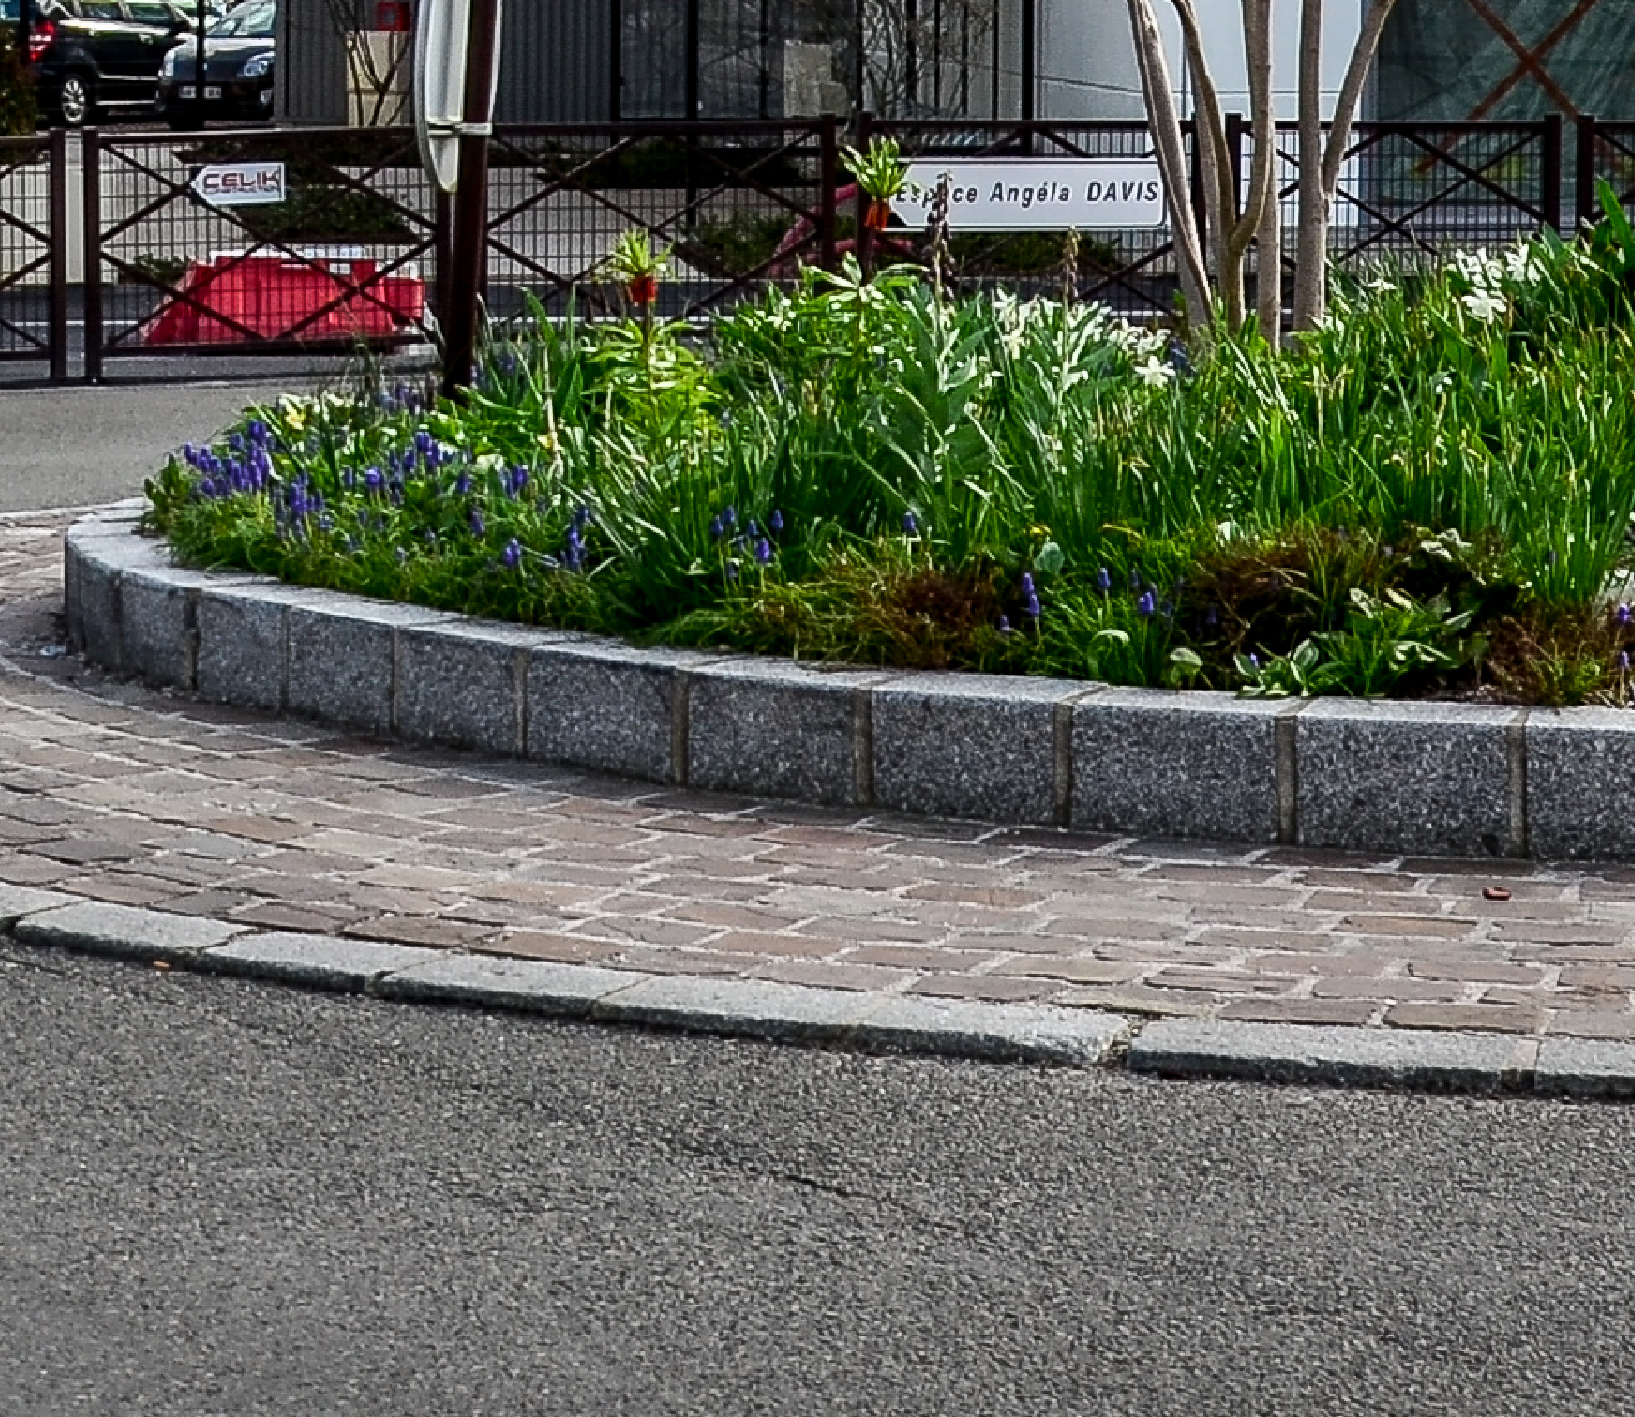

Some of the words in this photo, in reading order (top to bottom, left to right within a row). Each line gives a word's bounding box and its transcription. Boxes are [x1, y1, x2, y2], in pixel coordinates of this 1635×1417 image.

[203, 171, 280, 189] CELIK
[895, 182, 978, 208] Espce
[989, 181, 1070, 208] Angéla
[1086, 182, 1159, 202] DAVIS
